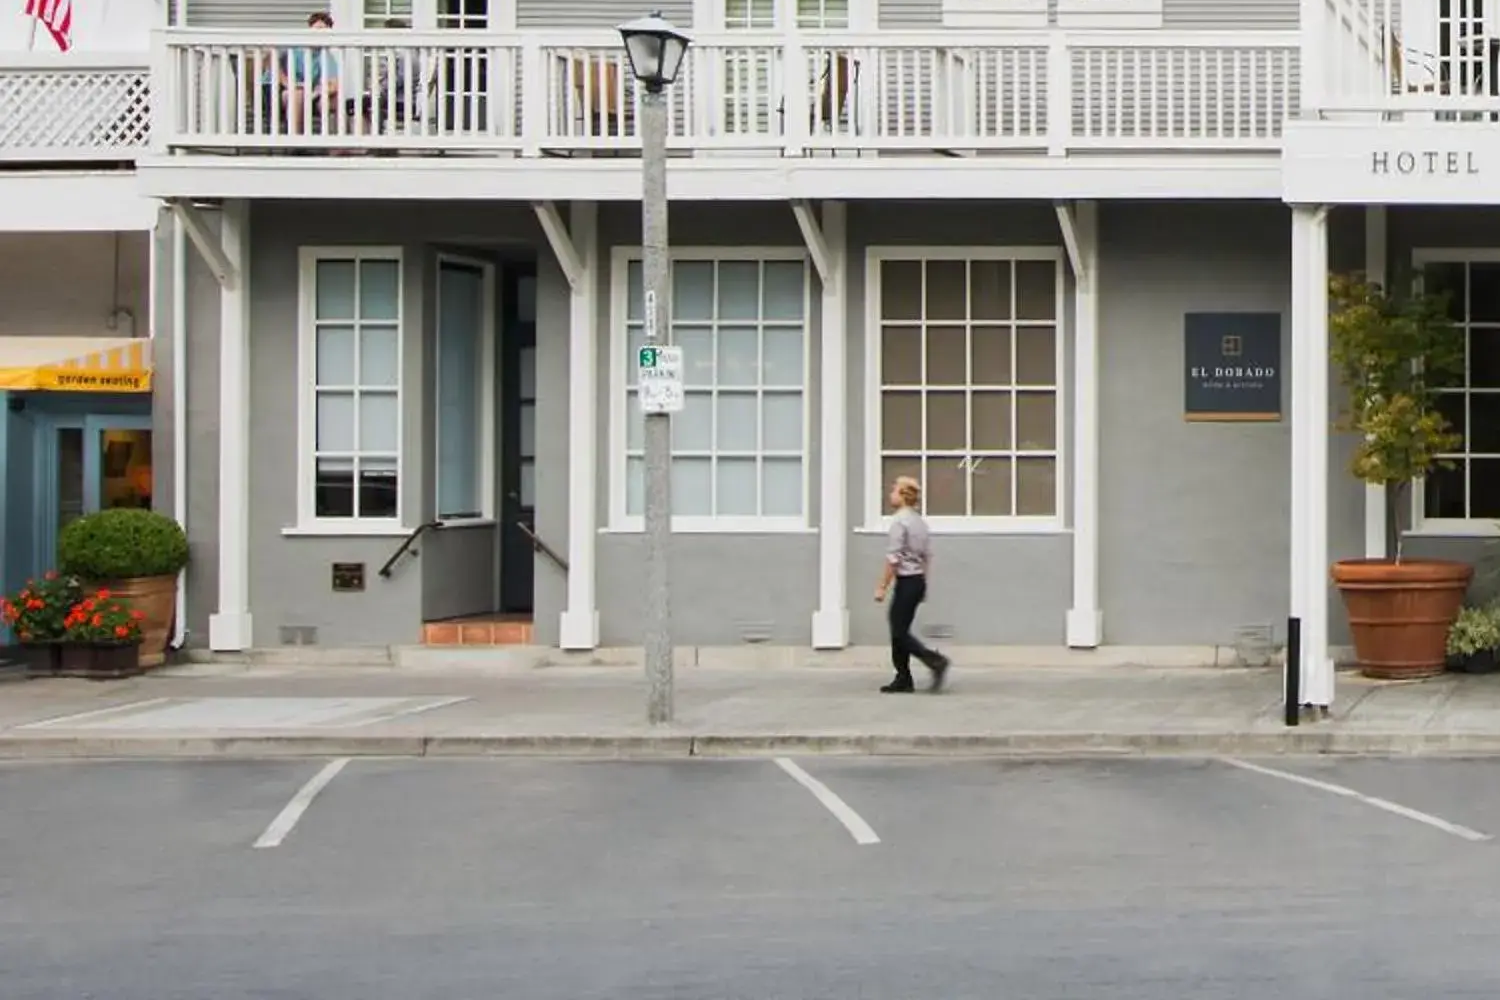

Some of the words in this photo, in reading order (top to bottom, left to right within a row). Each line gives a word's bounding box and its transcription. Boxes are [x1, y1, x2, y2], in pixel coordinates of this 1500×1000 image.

[1371, 151, 1479, 174] HOTEL
[642, 349, 654, 367] 3
[1191, 366, 1208, 377] EL
[1215, 366, 1275, 378] DORADO
